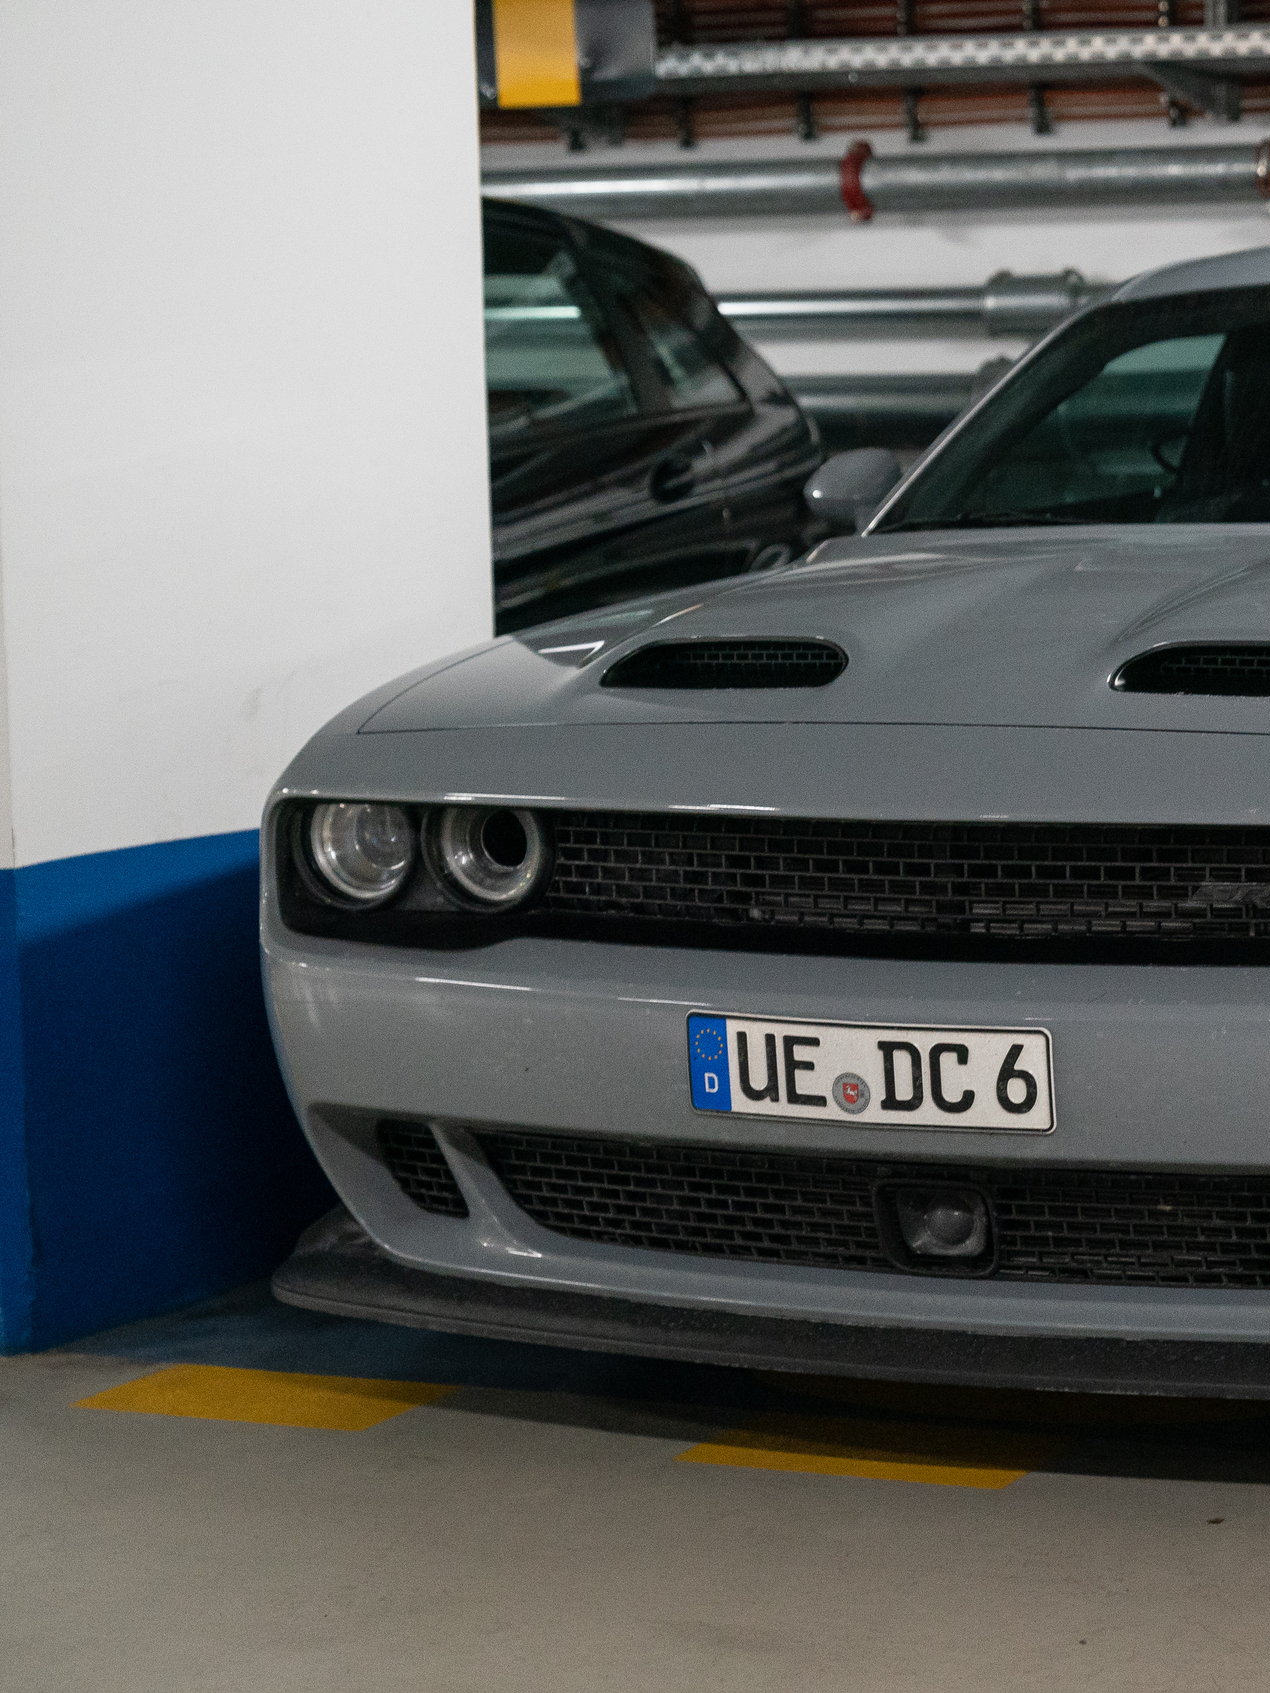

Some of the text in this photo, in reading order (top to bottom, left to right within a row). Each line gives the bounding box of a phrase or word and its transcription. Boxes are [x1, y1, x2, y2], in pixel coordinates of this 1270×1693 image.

[704, 1073, 719, 1093] D
[736, 1031, 827, 1107] UE
[877, 1040, 975, 1113] DC
[996, 1044, 1037, 1114] 6
